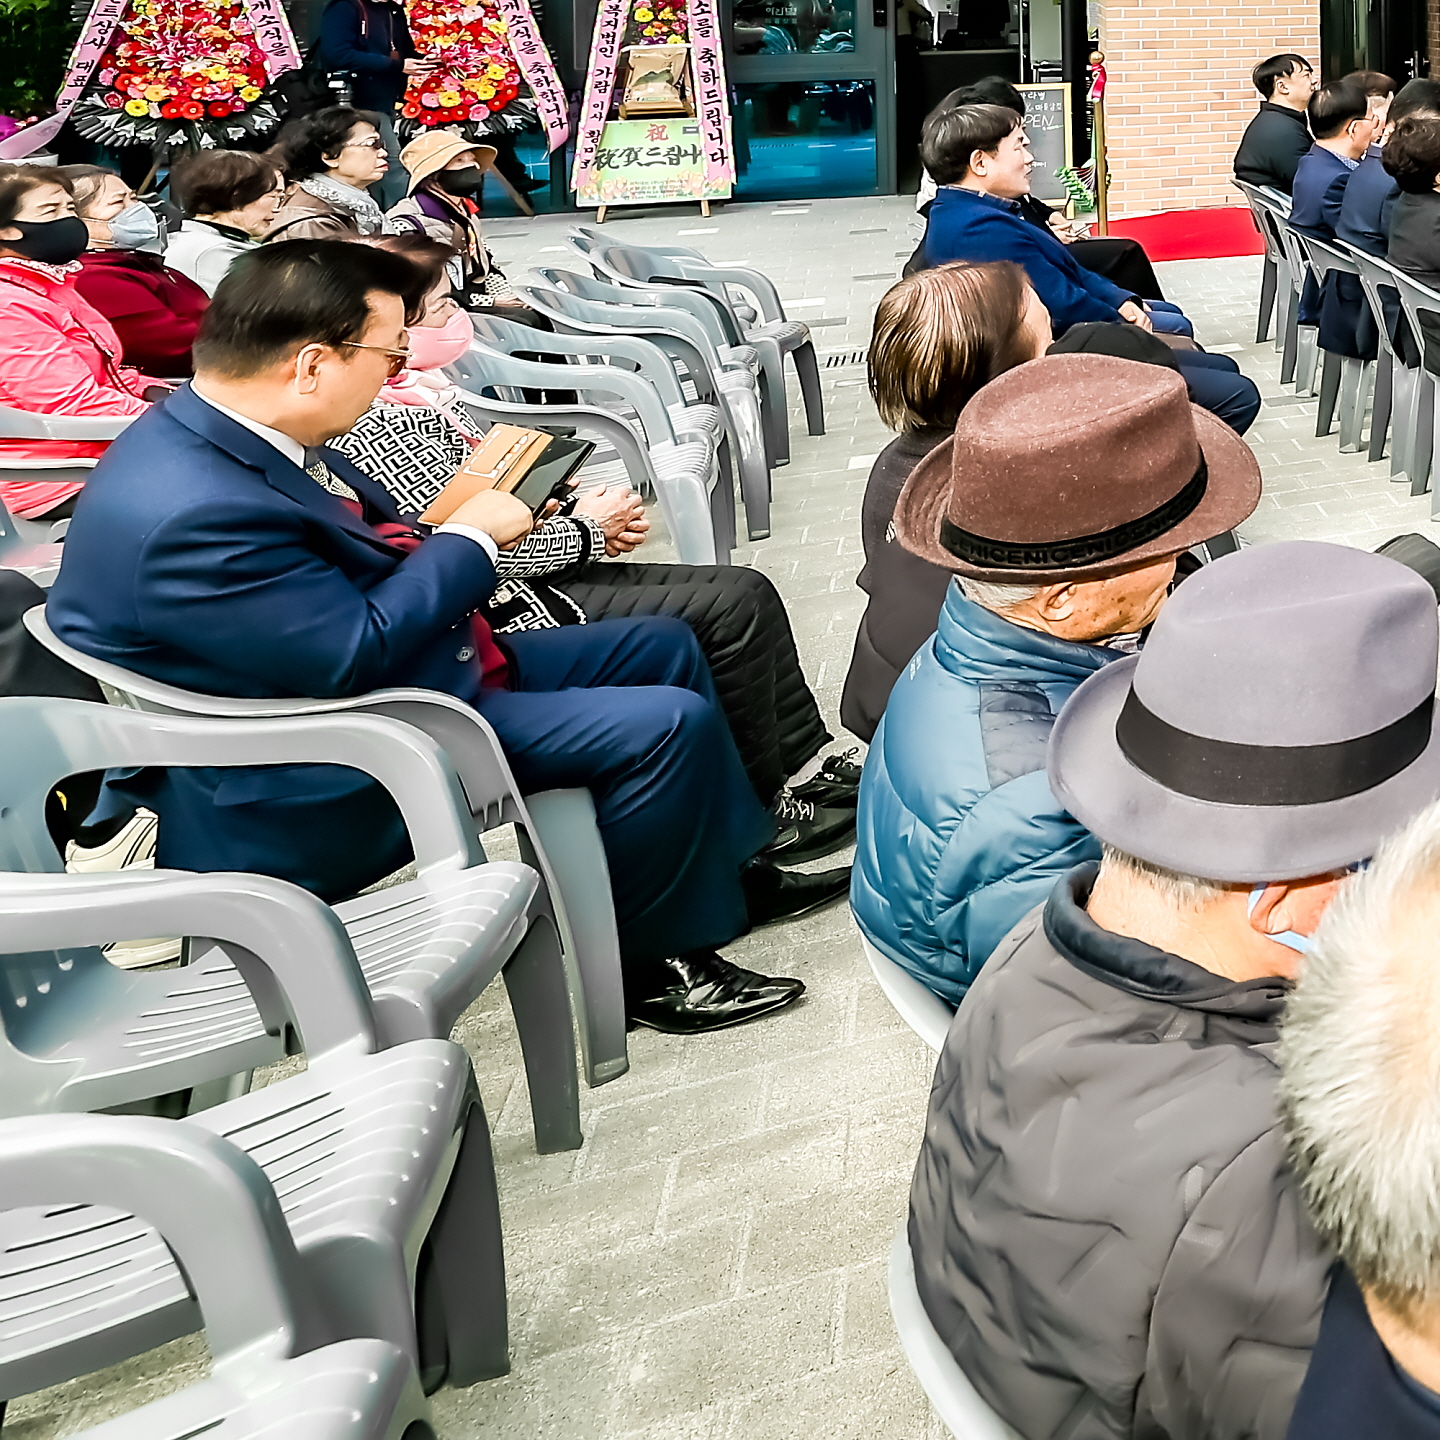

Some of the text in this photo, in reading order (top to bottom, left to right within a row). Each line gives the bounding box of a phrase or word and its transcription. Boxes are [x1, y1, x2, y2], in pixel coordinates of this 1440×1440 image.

[502, 0, 539, 55] 개소식을
[67, 59, 93, 87] 대표
[593, 66, 614, 94] 가람
[527, 61, 568, 130] 축하합니다
[698, 47, 729, 167] 축하드립니다
[590, 101, 605, 122] 이사
[1023, 113, 1055, 128] PEN
[644, 123, 670, 142] 祝
